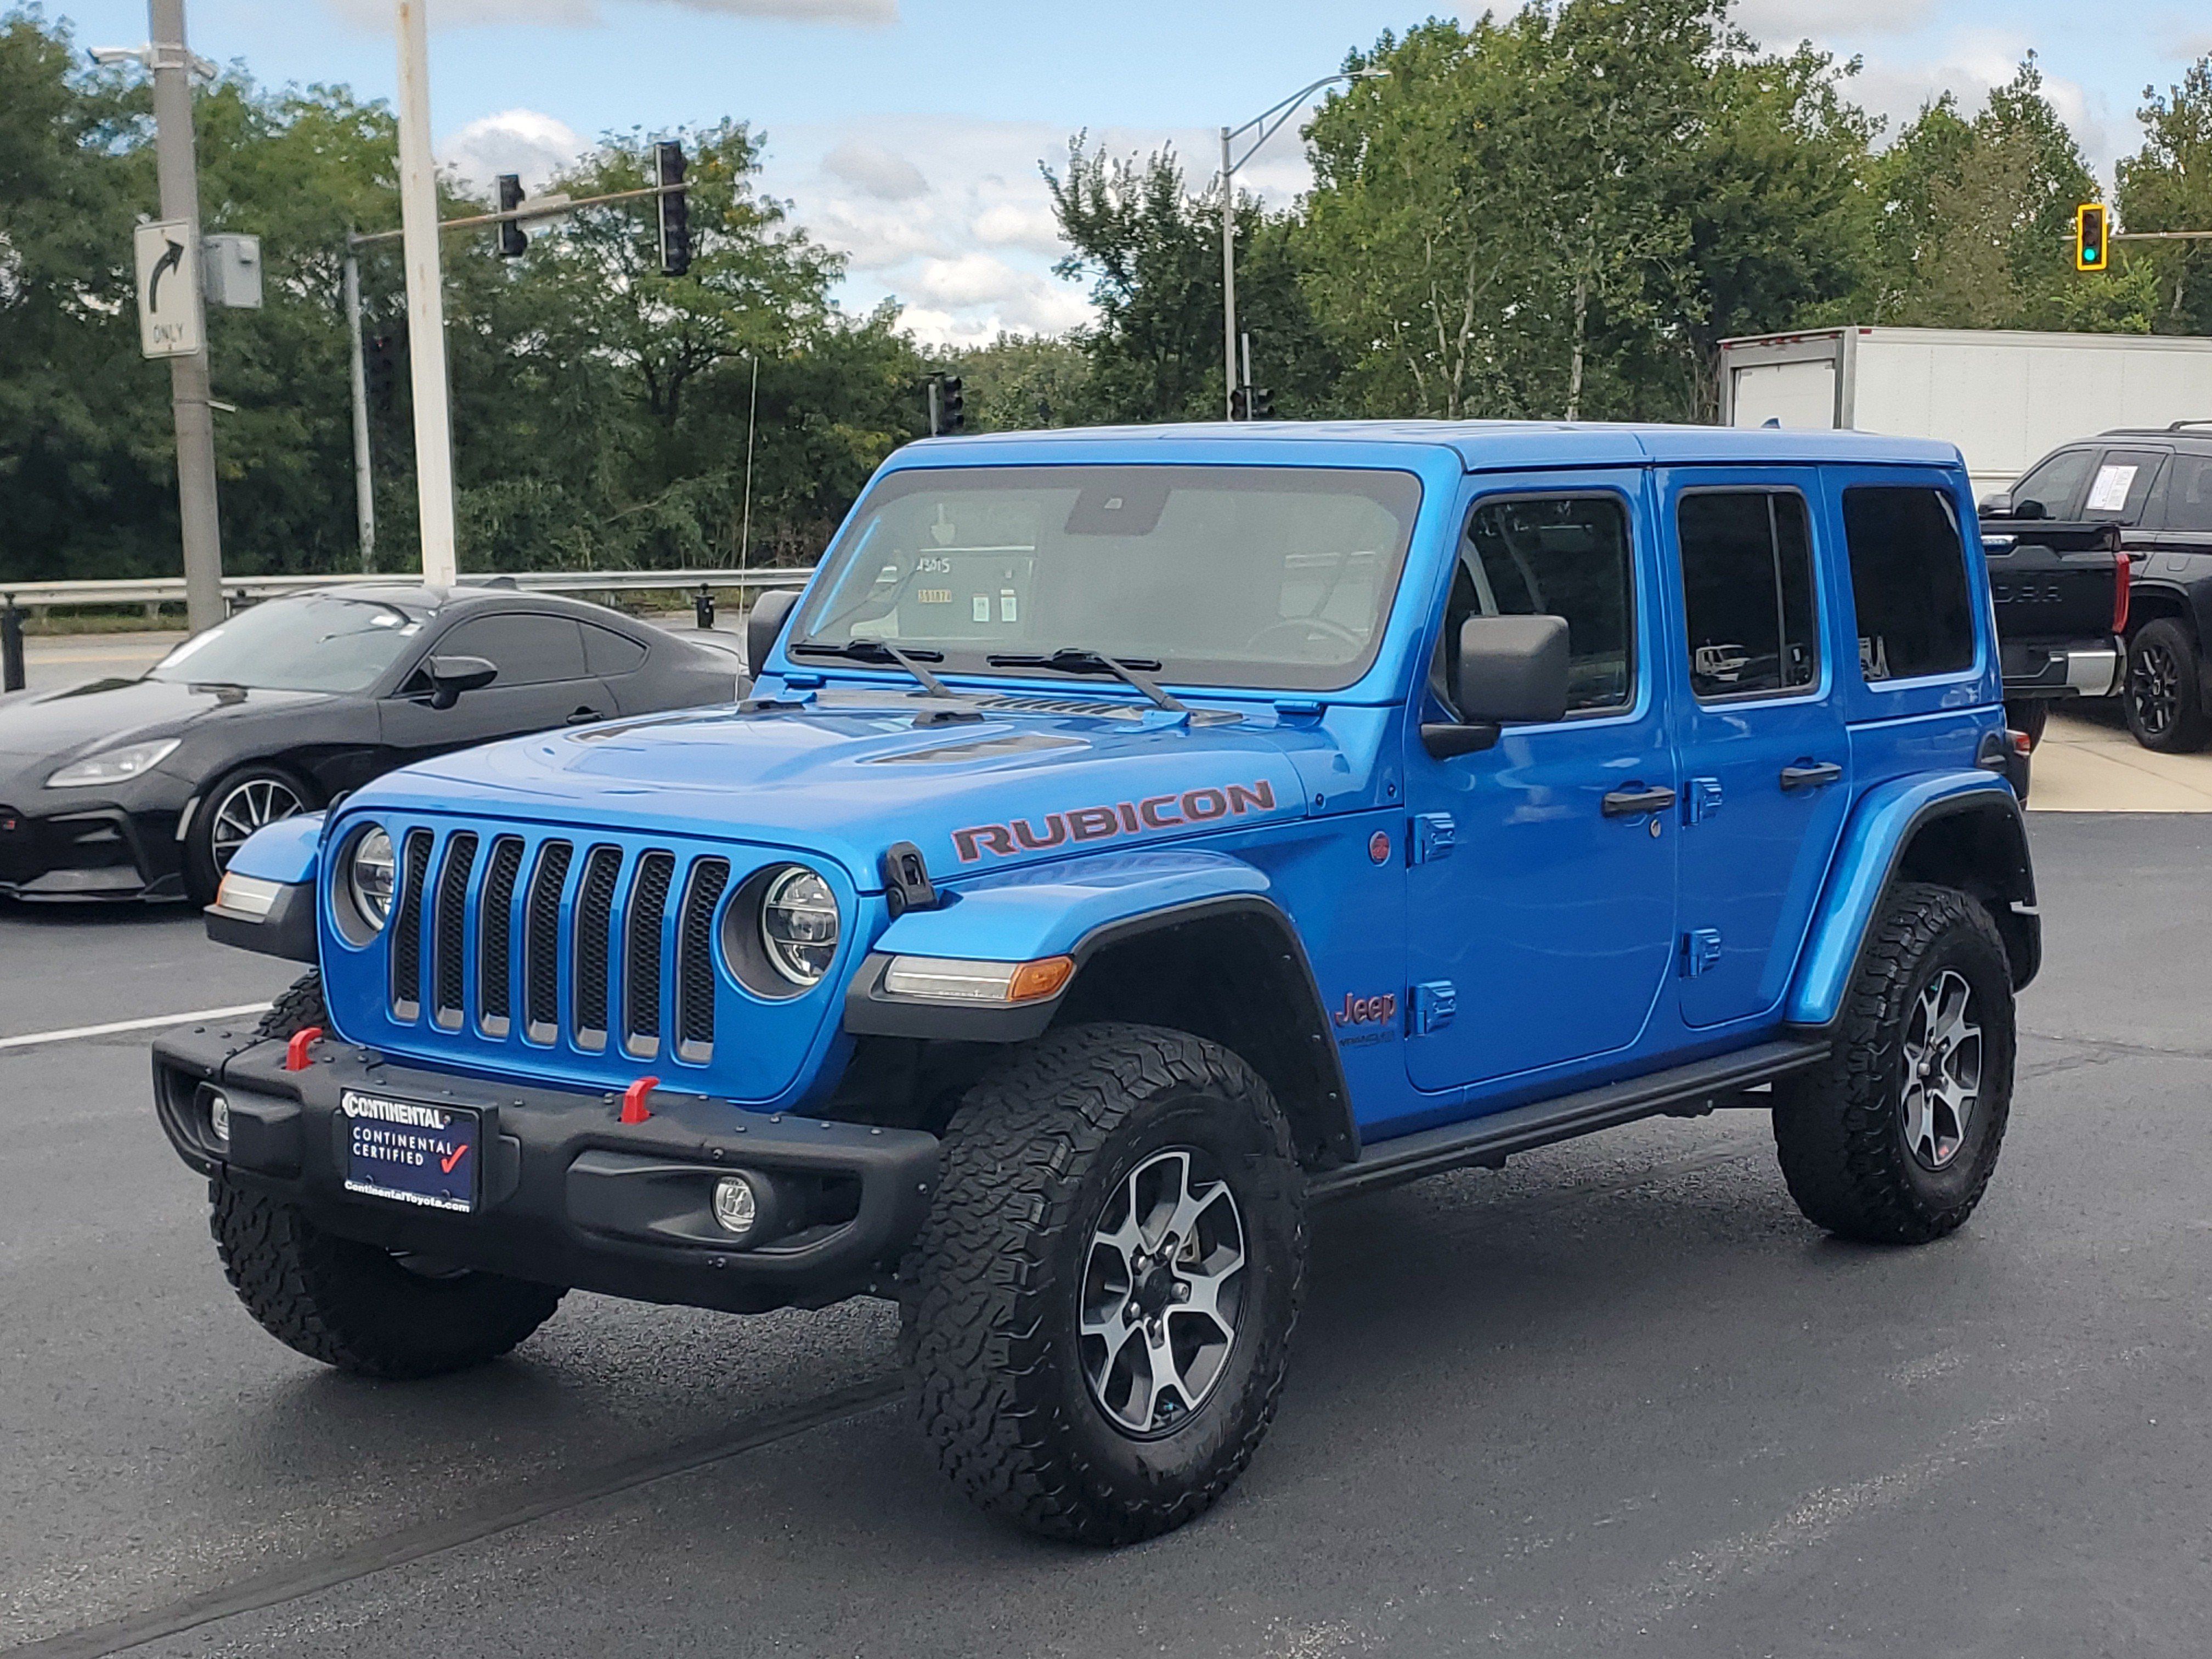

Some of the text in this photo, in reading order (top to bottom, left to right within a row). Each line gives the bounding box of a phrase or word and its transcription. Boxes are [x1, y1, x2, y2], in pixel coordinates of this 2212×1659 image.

[154, 323, 183, 343] ONLY
[951, 779, 1276, 864] RUBICON
[1335, 992, 1396, 1028] Jeep
[342, 1092, 445, 1130] CONTINENTAL
[353, 1126, 453, 1155] CONTINENTAL
[353, 1142, 424, 1166] CERTIFIED
[344, 1180, 470, 1213] ContinentalToyota.com
